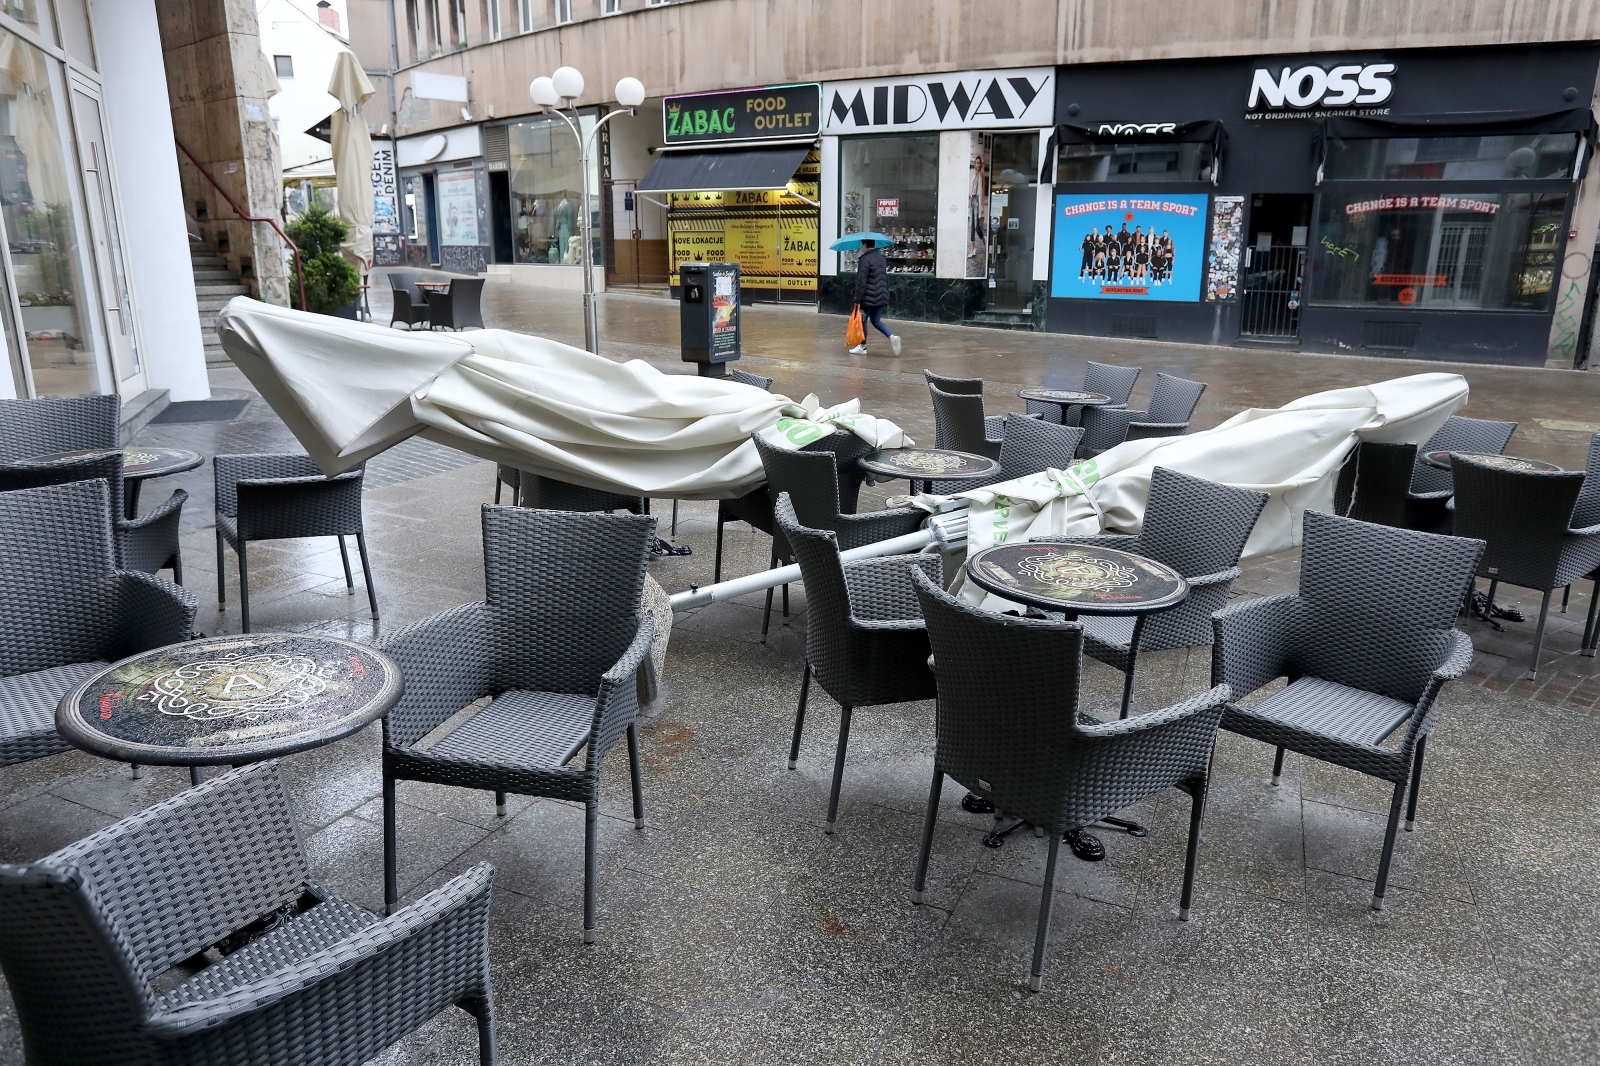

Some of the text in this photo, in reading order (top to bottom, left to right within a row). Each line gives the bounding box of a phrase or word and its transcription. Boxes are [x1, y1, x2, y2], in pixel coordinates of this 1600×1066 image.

[1247, 63, 1395, 108] NOSS
[746, 96, 786, 113] FOOD
[826, 75, 1050, 128] MIDWAY
[754, 112, 812, 130] OUTLET
[1265, 111, 1313, 119] ORDINARY
[1314, 110, 1357, 118] SNEAKER
[1359, 108, 1390, 116] STORE
[382, 150, 394, 194] DENIM
[1064, 199, 1198, 218] CHANGE IS A TEAM SPORT
[1345, 196, 1501, 215] CHANGE IS A TEAM SPORT
